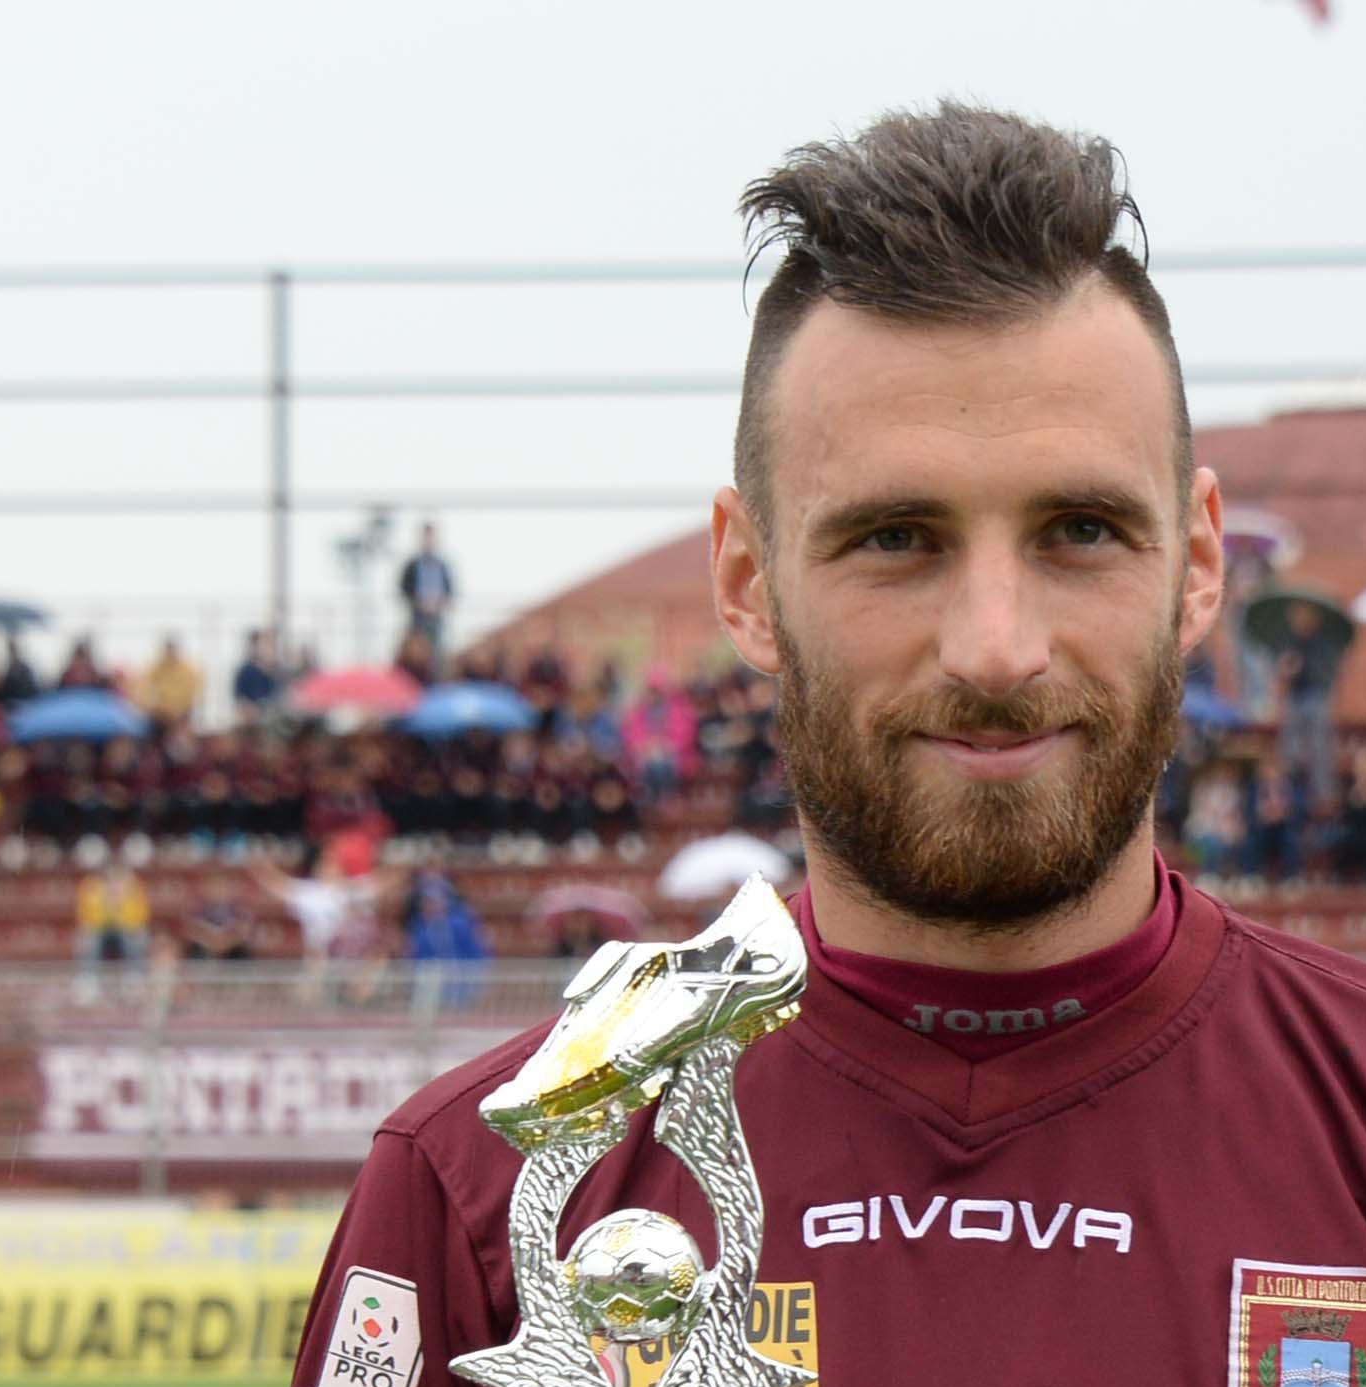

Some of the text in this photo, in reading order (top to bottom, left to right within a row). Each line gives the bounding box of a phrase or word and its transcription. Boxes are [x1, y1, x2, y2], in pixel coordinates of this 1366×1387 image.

[904, 998, 1088, 1035] Joma
[802, 1194, 1133, 1254] GIVOVA
[341, 1340, 395, 1370] LEGA
